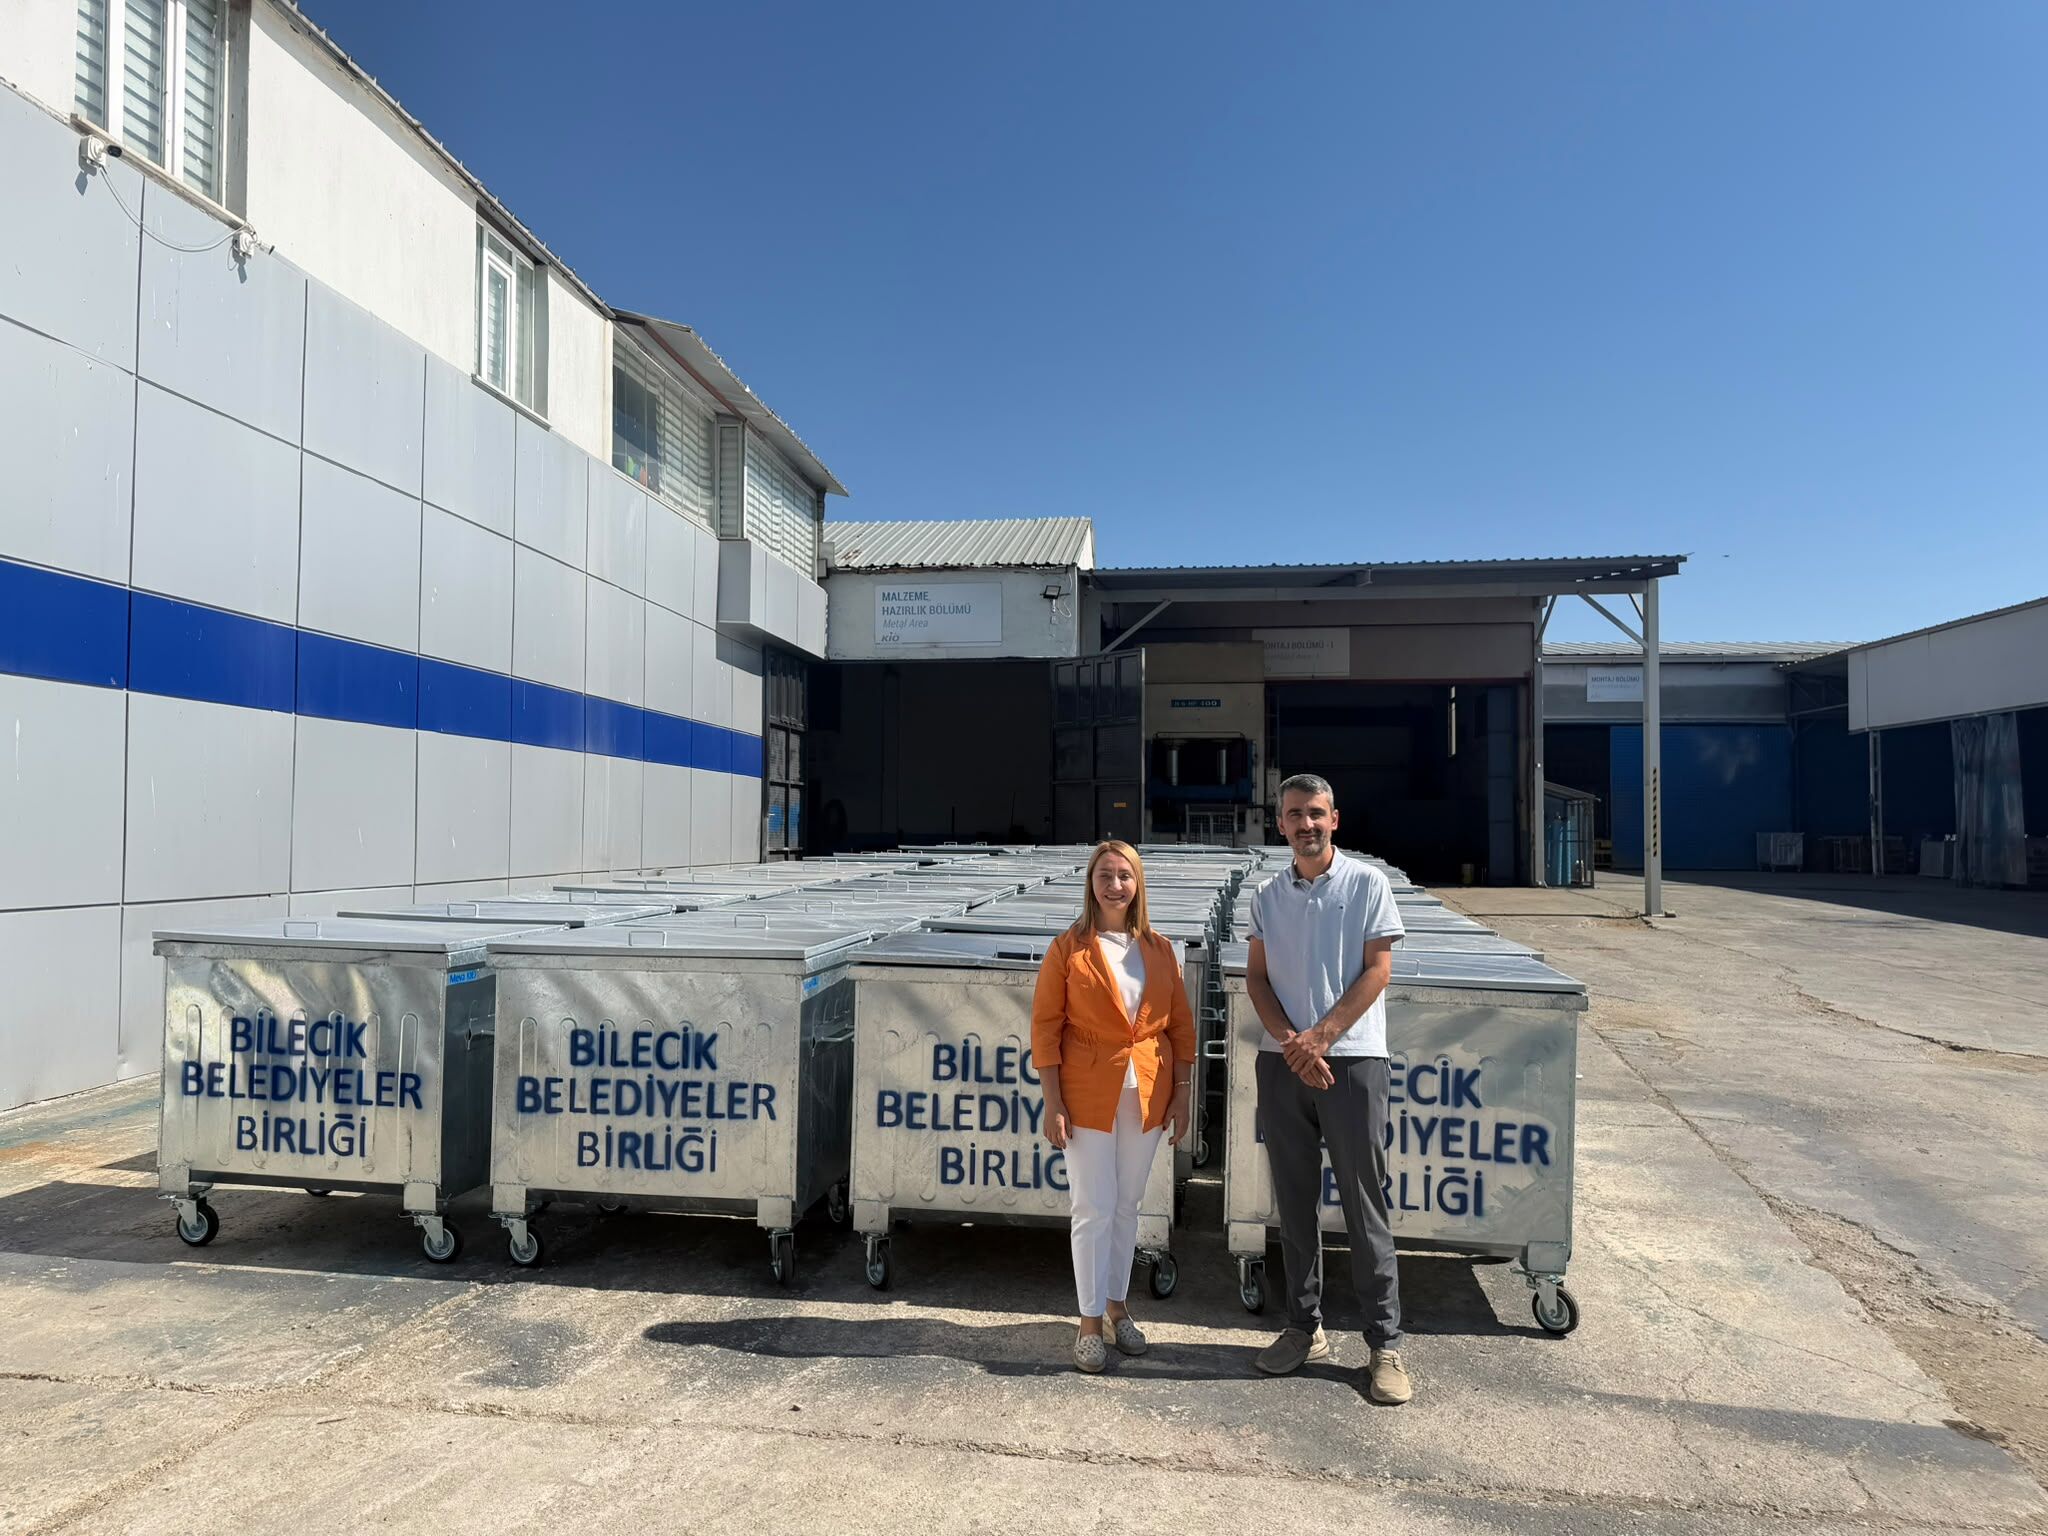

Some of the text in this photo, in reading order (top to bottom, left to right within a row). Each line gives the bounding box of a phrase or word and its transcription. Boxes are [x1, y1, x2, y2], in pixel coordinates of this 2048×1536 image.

[882, 591, 929, 601] MALZEME
[882, 602, 971, 616] HAZIRLIK BÖLÜMÜ
[883, 618, 929, 629] Metal Area
[230, 1012, 367, 1058] BİLECİK
[569, 1024, 718, 1070] BİLECİK
[932, 1039, 1041, 1085] BİLEC
[1388, 1061, 1483, 1109] ECİK
[182, 1061, 423, 1110] BELEDİYELER
[517, 1074, 776, 1121] BELEDİYELER
[236, 1110, 367, 1158] BİRLİĞİ
[877, 1089, 1044, 1134] BELEDİY
[577, 1125, 717, 1172] BİRLİĞİ
[940, 1143, 1070, 1191] BİRLİĞ
